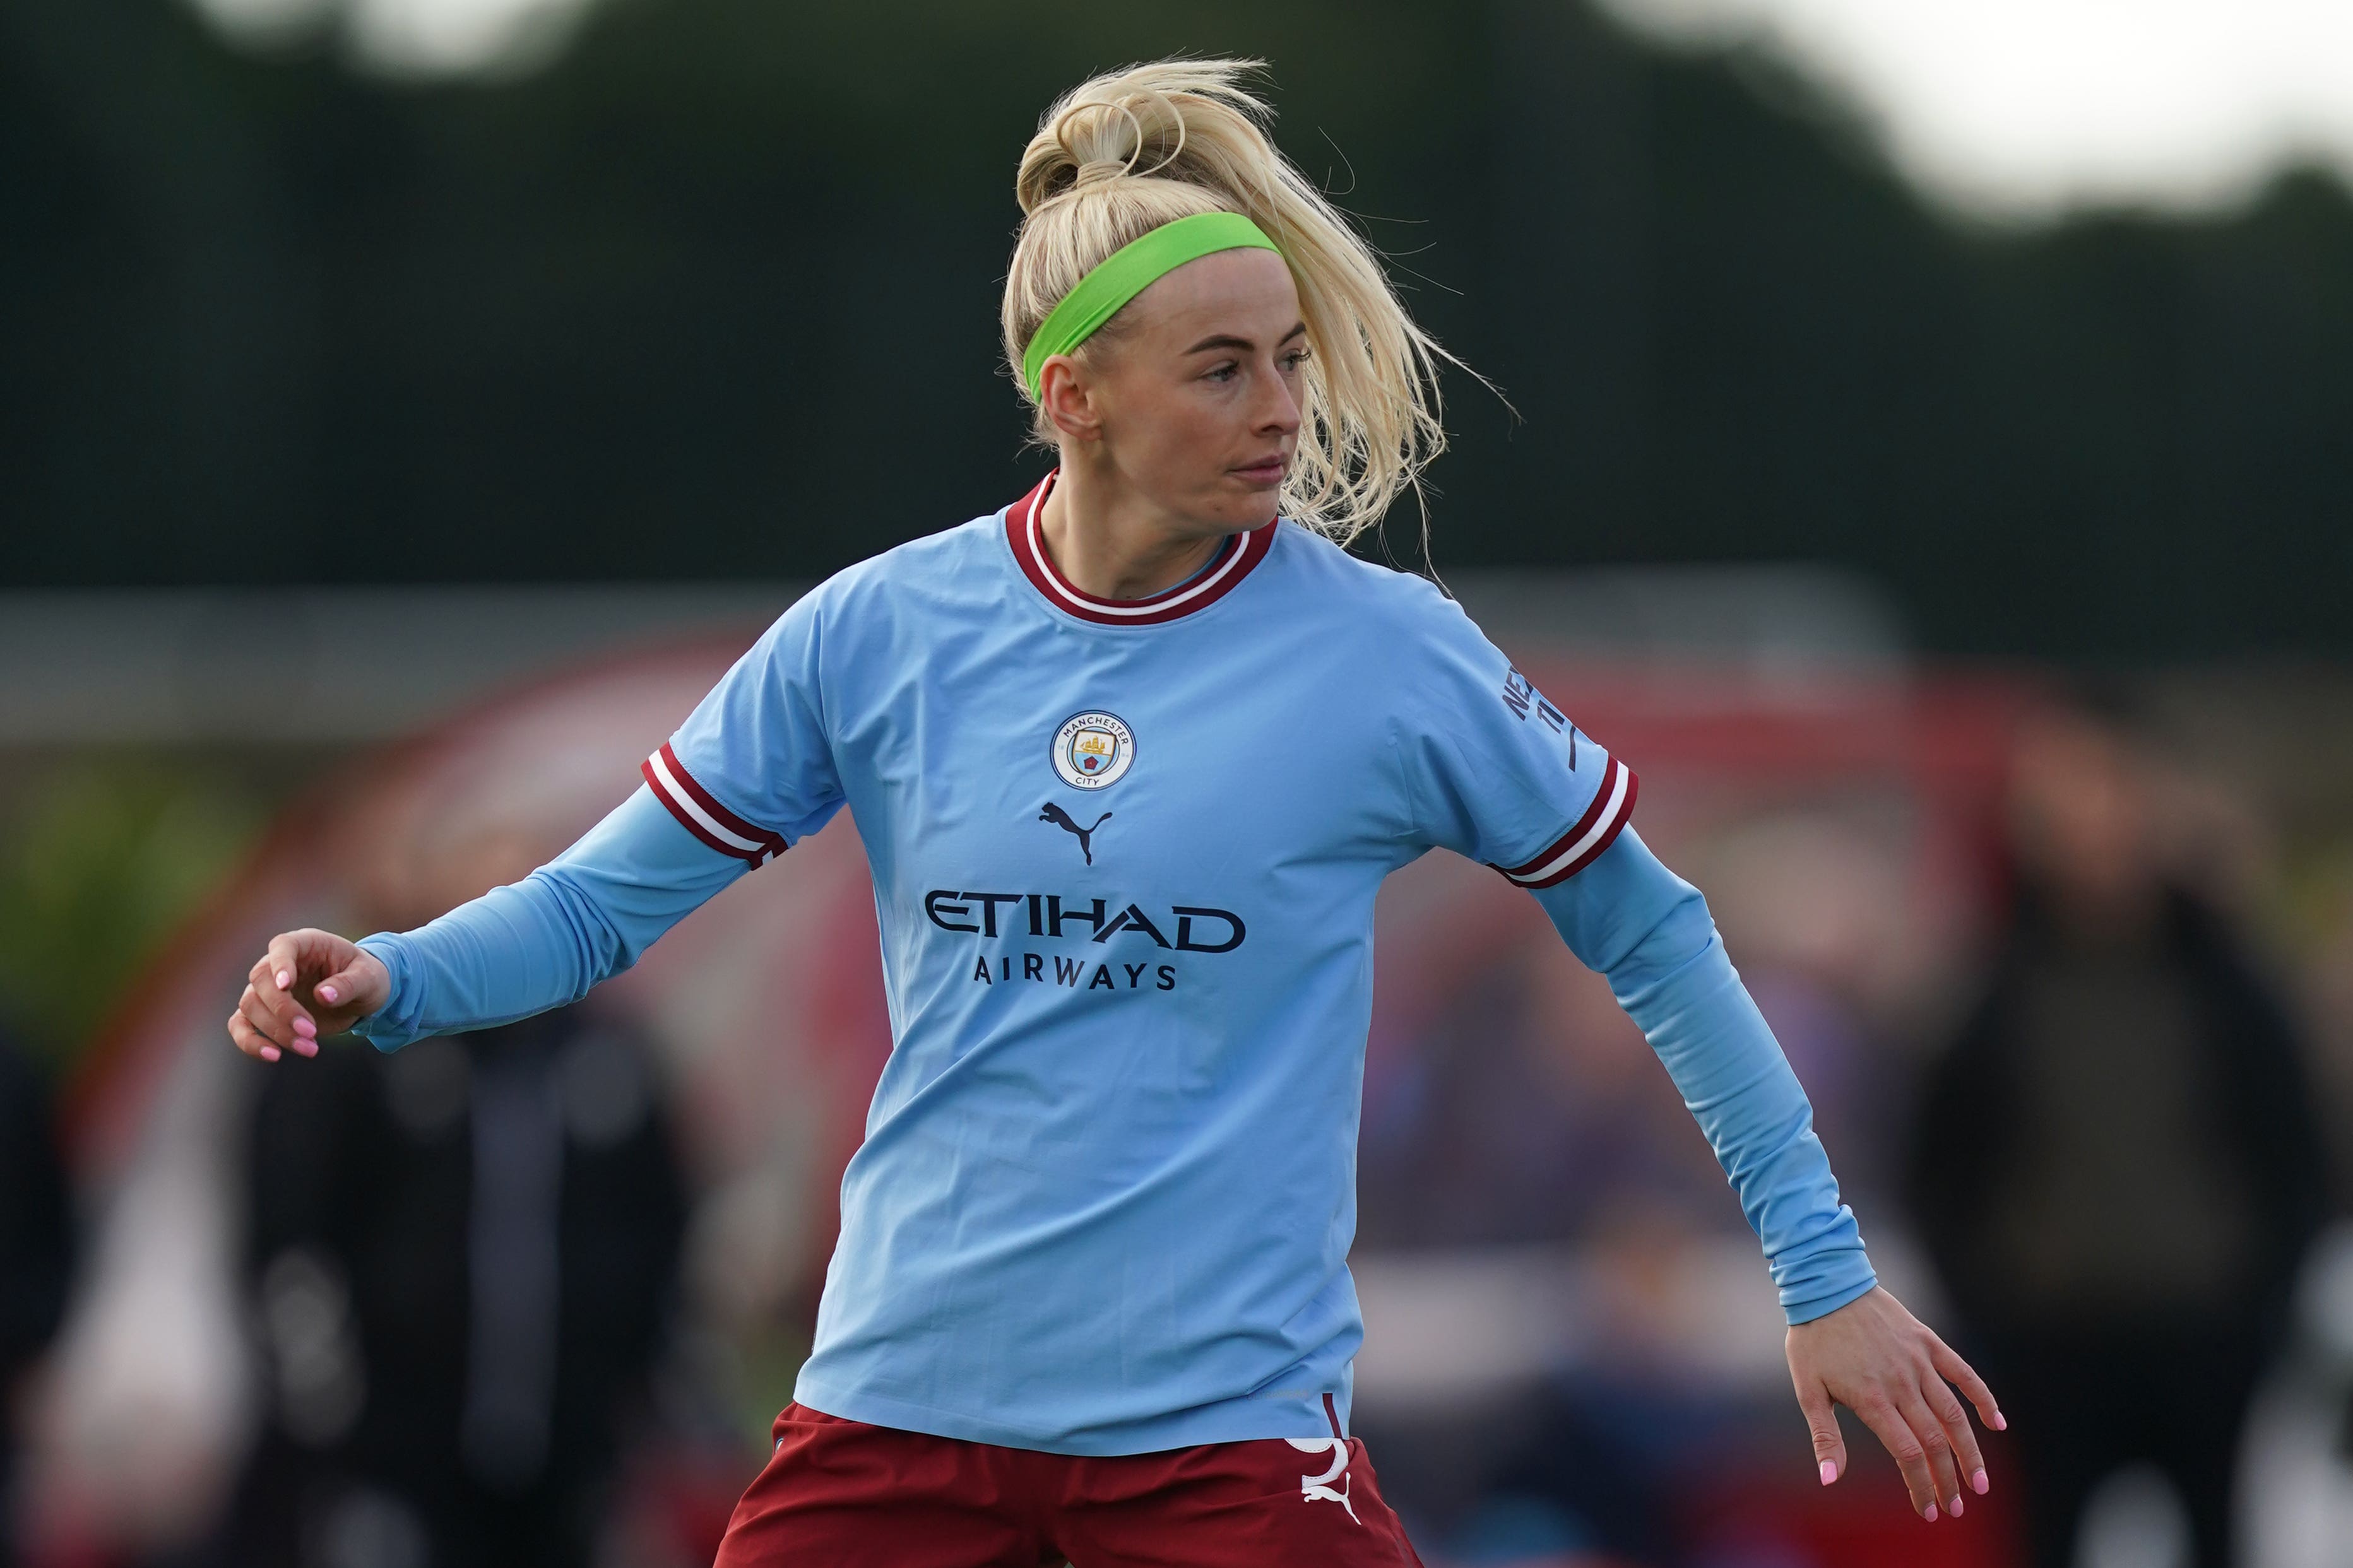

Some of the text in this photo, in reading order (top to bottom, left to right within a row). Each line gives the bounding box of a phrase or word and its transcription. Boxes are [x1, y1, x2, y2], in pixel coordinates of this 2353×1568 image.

[1063, 717, 1129, 745] MANCHESTER
[1076, 777, 1100, 786] CITY
[924, 890, 1247, 953] ETIHAD
[974, 953, 1176, 991] AIRWAYS
